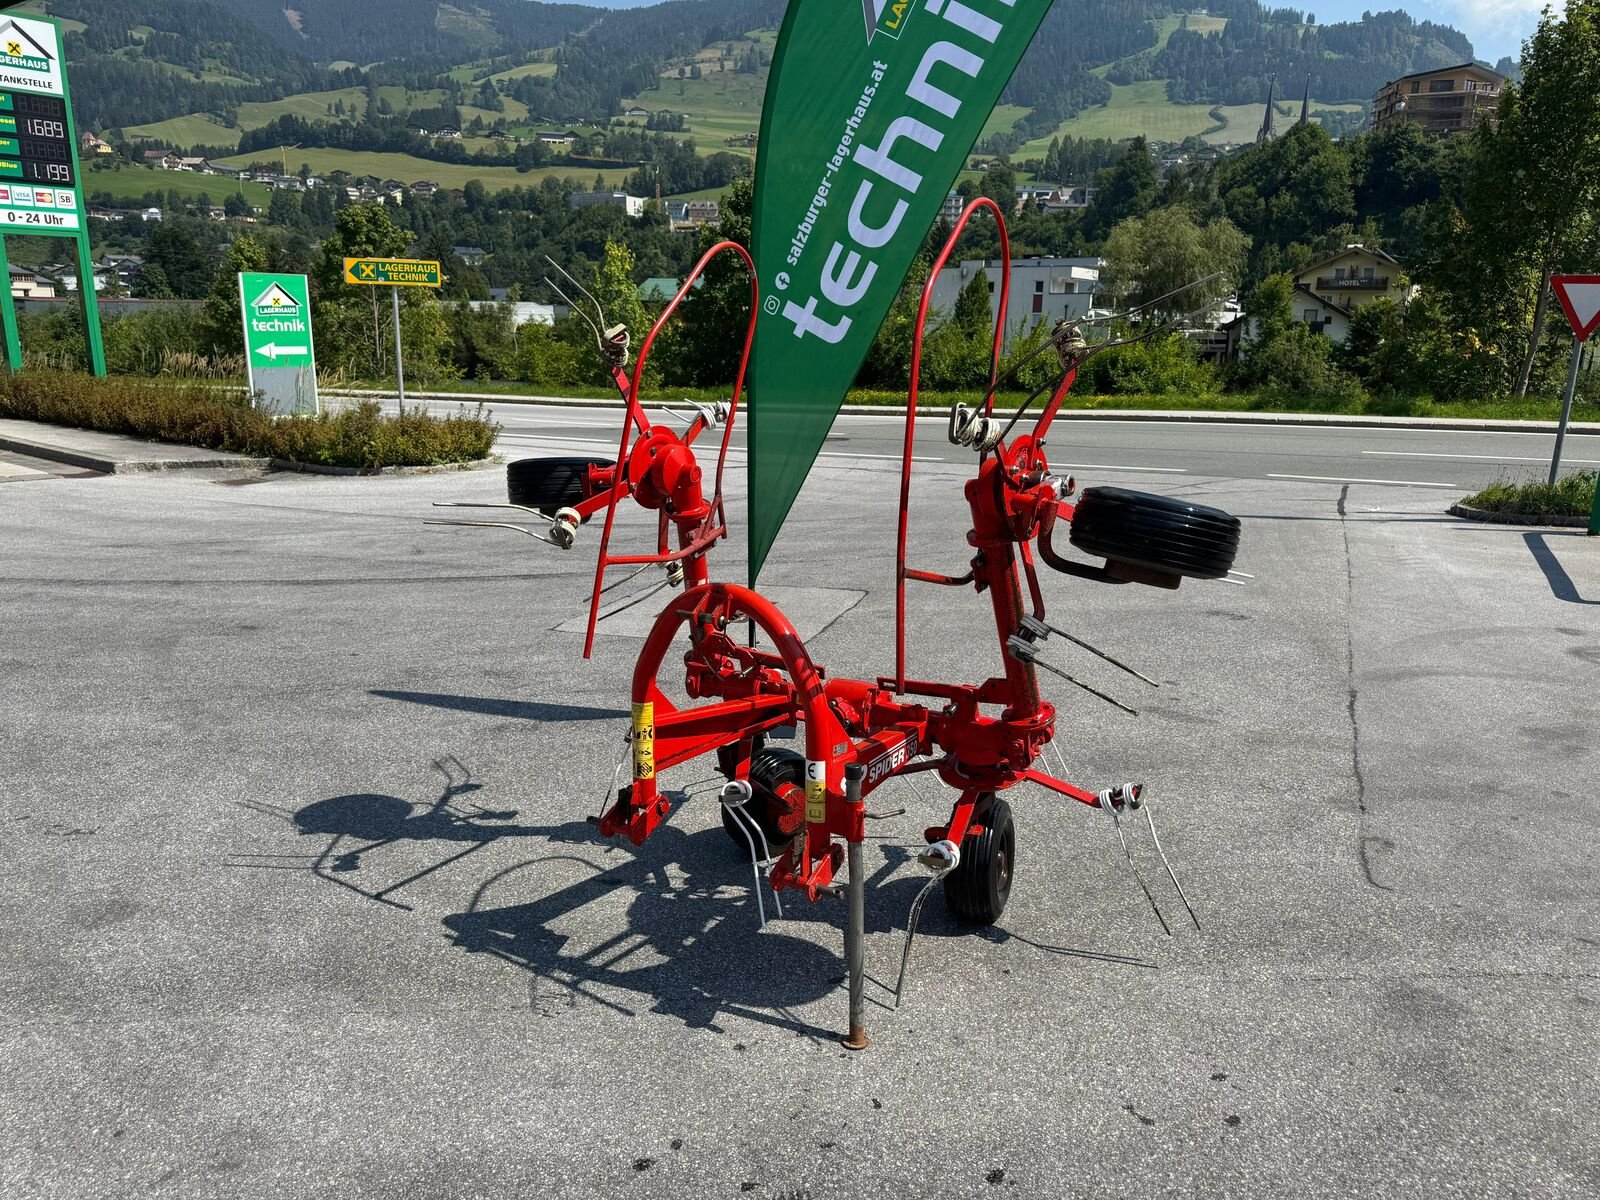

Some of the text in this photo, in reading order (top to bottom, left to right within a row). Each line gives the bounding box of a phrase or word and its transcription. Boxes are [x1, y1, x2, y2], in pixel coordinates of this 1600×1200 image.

[0, 74, 53, 89] TANKSTELLE
[27, 118, 64, 138] 1.689
[786, 59, 888, 266] salzburger-lagerhaus.at
[34, 163, 70, 182] 1.199
[782, 0, 1017, 344] techni
[8, 212, 16, 222] 0
[25, 212, 40, 224] 24
[44, 214, 64, 225] Uhr
[378, 262, 437, 273] LAGERHAUS
[388, 272, 428, 282] TECHNIK
[258, 306, 297, 314] LAGERHAUS
[251, 318, 306, 332] technik
[869, 747, 906, 784] SPIDER
